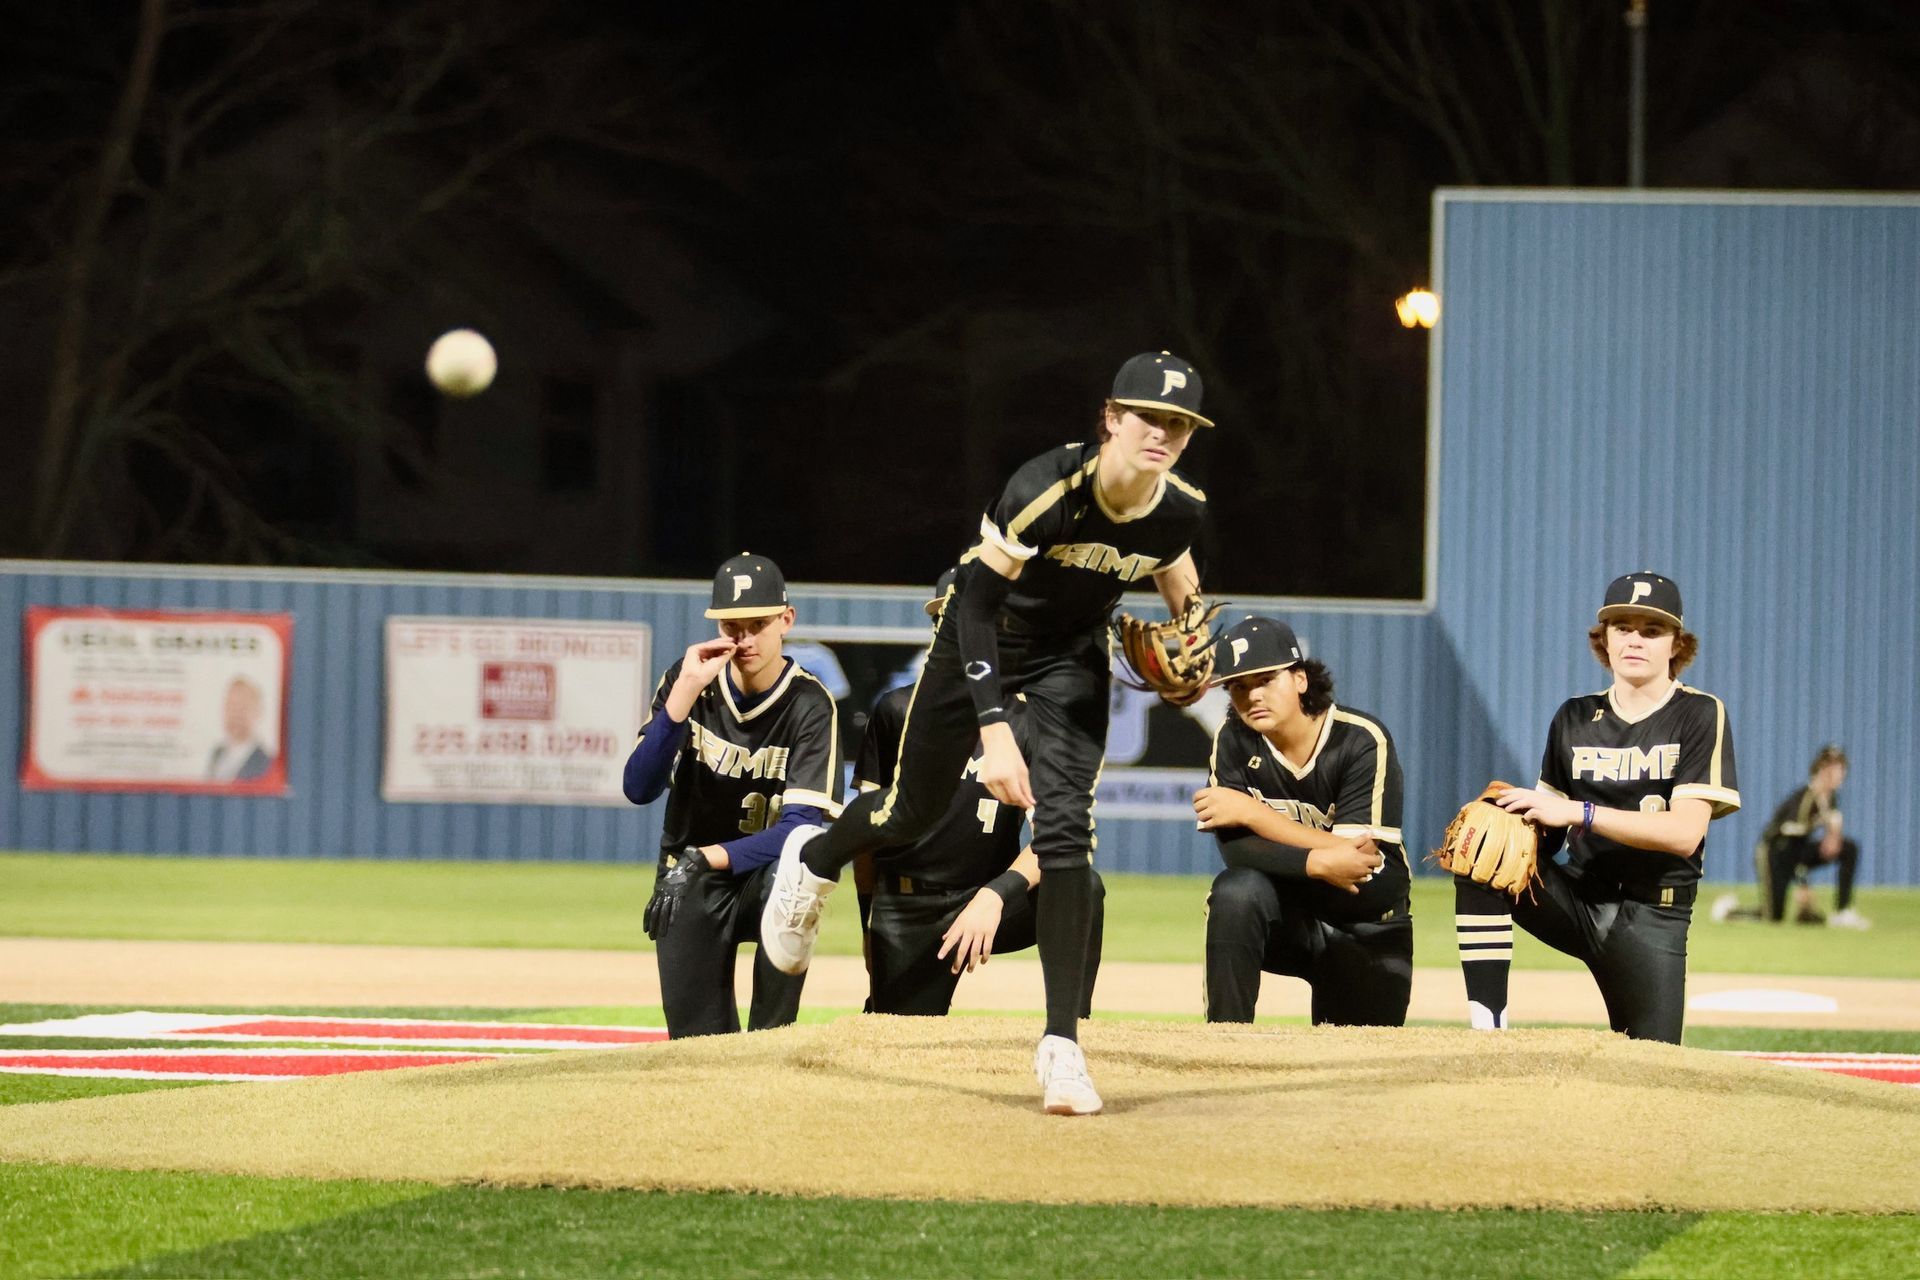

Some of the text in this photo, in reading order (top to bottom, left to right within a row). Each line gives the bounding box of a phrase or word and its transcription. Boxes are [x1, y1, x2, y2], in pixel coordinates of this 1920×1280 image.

[1161, 370, 1187, 396] P
[733, 575, 753, 602] P
[1630, 582, 1652, 604] P
[1231, 638, 1249, 667] P
[1572, 744, 1680, 781] PRIME
